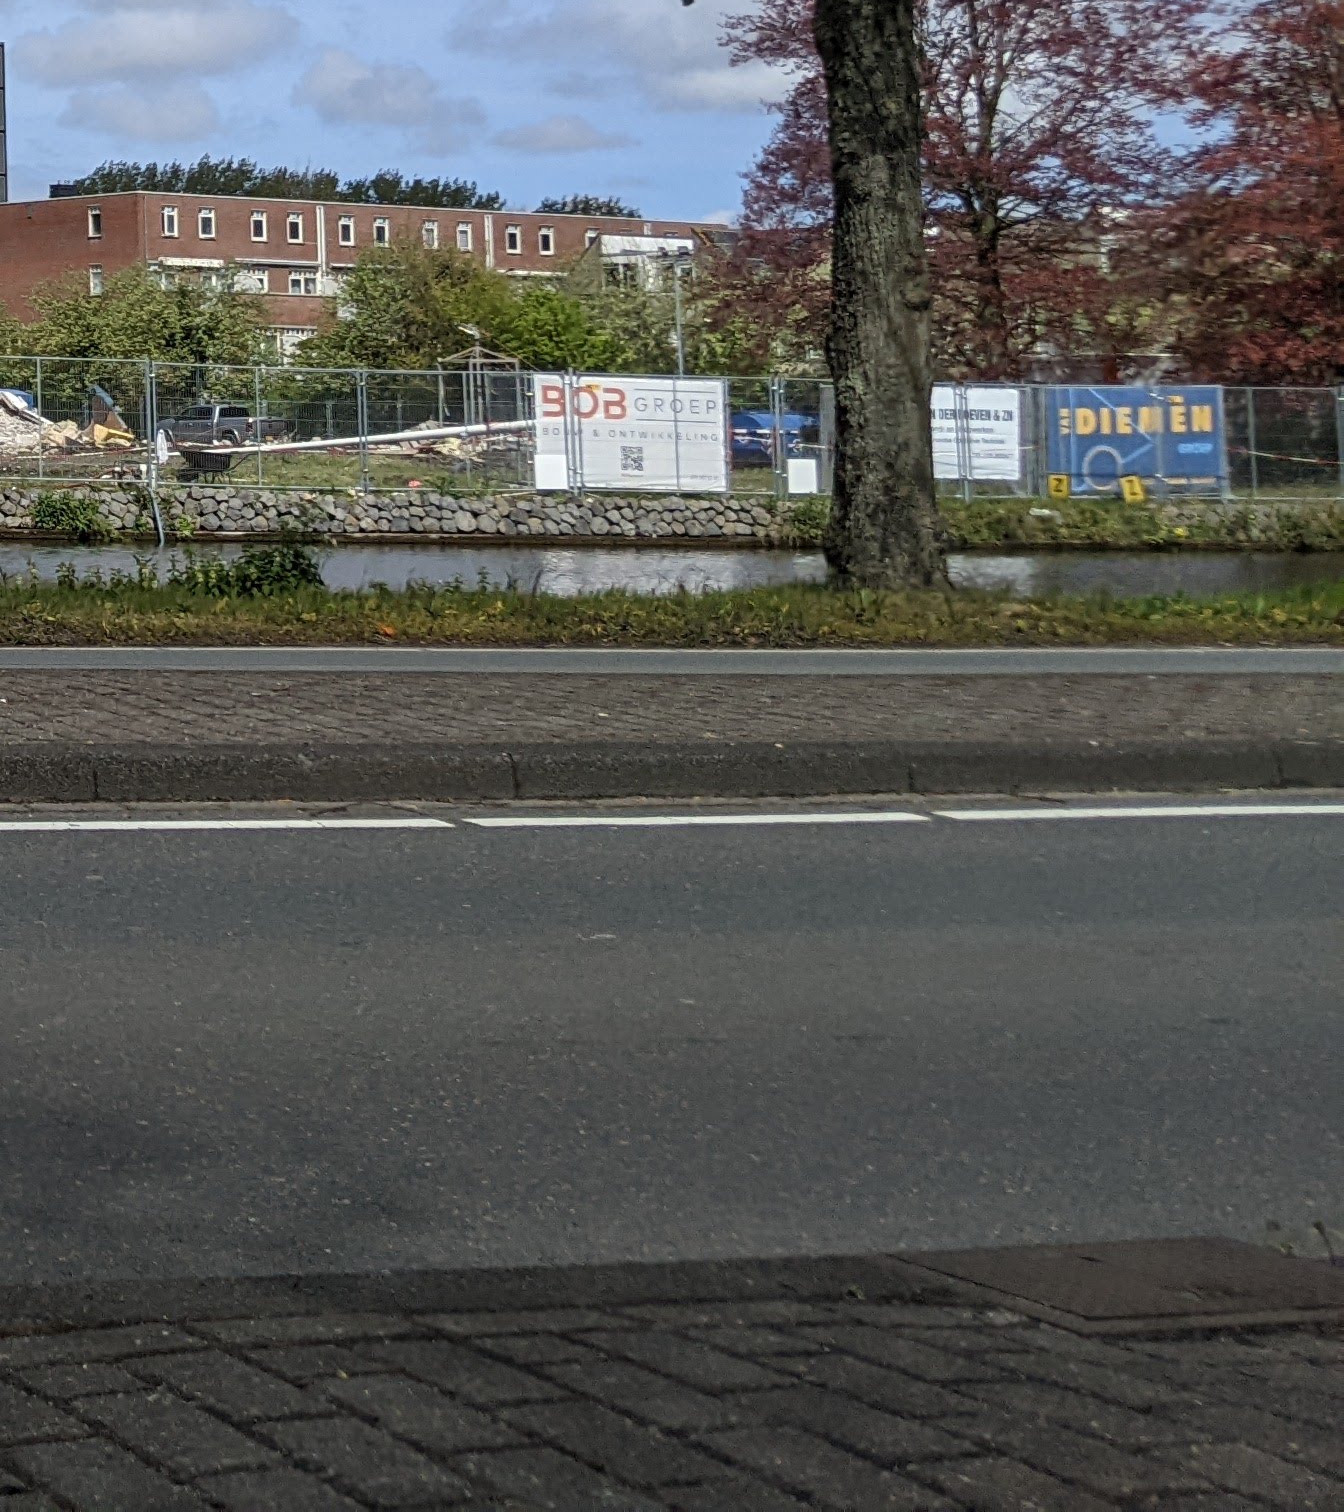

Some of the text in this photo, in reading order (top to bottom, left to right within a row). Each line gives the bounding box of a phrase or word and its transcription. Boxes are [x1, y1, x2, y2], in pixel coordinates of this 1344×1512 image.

[541, 384, 717, 420] BOB GROEP
[958, 409, 991, 421] EVEN
[542, 427, 583, 437] BO
[608, 429, 718, 442] ONTWIKKELING
